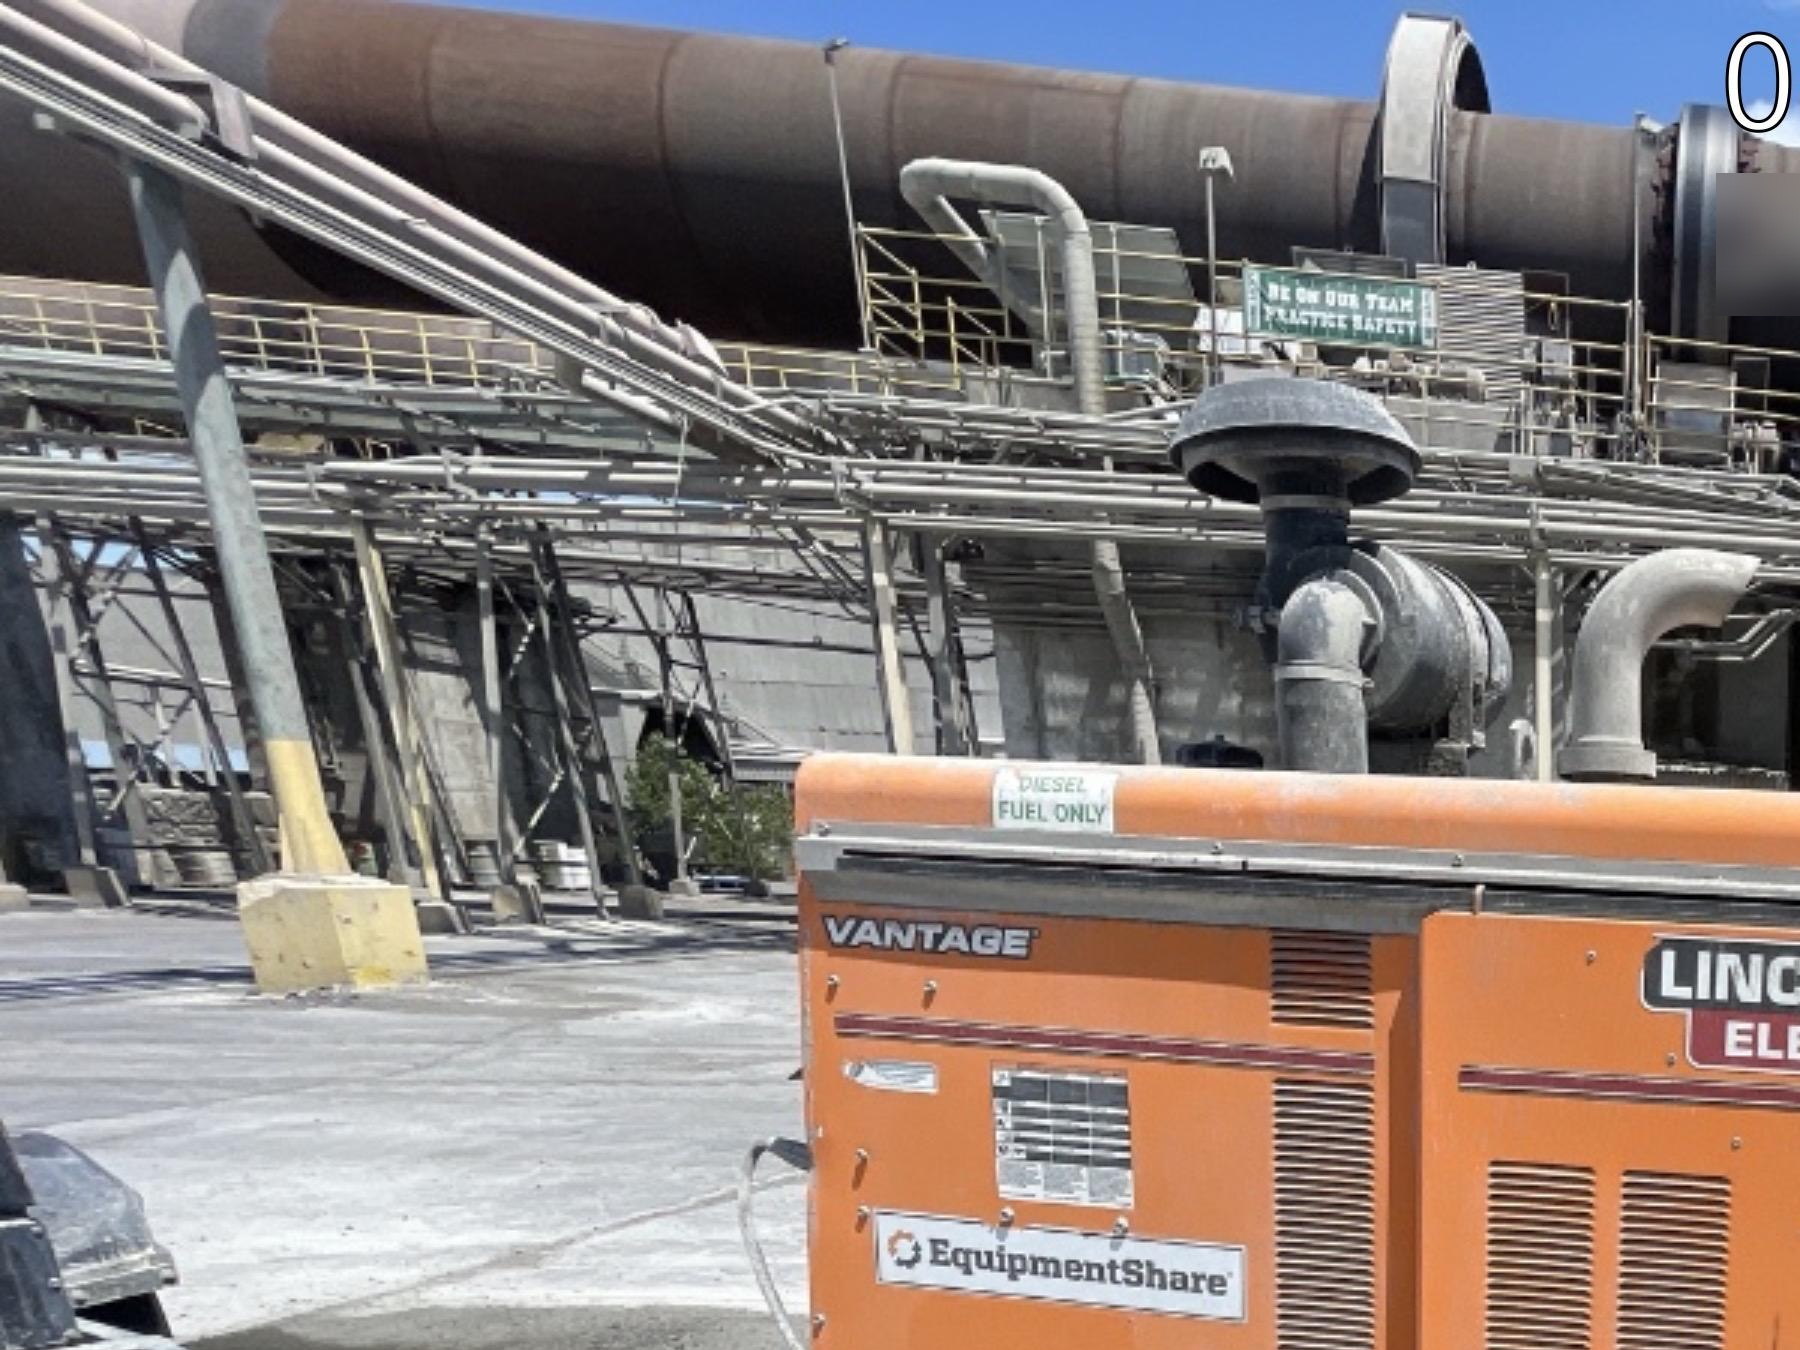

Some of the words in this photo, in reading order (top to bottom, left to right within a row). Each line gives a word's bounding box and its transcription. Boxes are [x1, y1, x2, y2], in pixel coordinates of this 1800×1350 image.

[1365, 293, 1414, 313] TEAM
[1352, 314, 1417, 335] SAFETY
[1019, 776, 1089, 793] DIESEL
[998, 800, 1048, 822] FUEL
[1054, 803, 1107, 824] ONLY
[822, 914, 1033, 957] VANTAGE
[928, 1237, 1229, 1297] EquipmentShare
